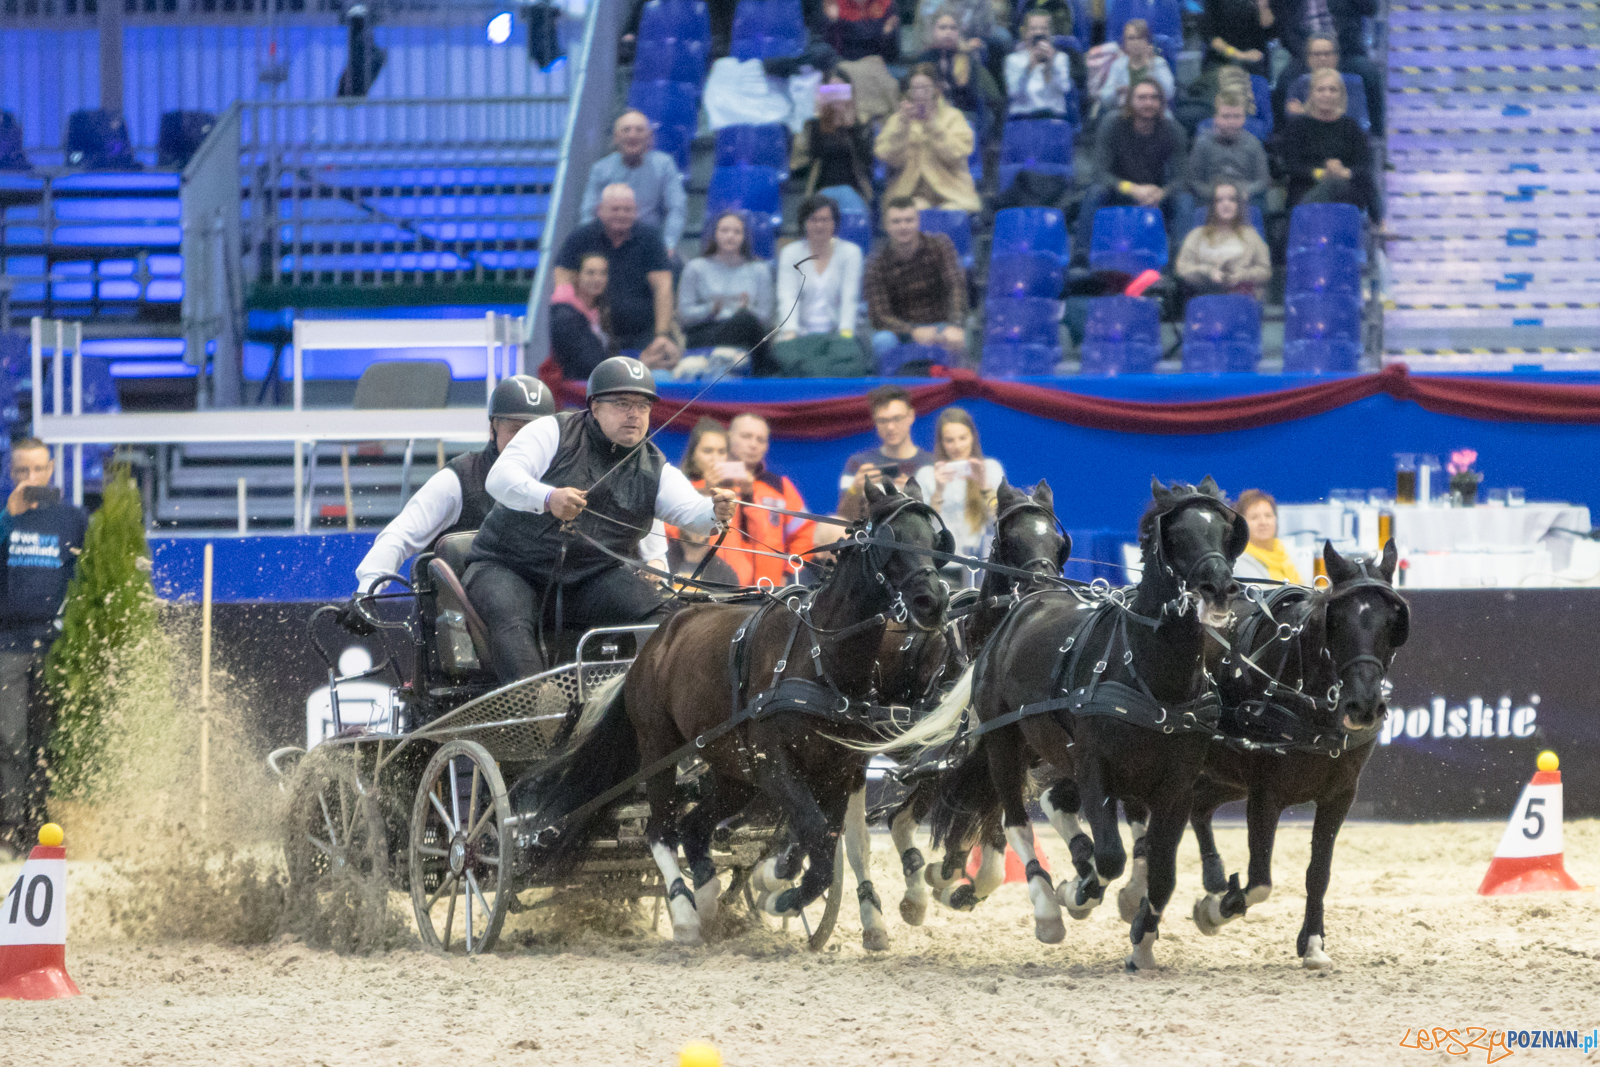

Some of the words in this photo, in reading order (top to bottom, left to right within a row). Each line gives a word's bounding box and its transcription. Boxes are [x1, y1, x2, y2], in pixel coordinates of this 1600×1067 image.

[1380, 697, 1537, 745] polskie
[1522, 797, 1546, 840] 5
[8, 874, 54, 927] 10
